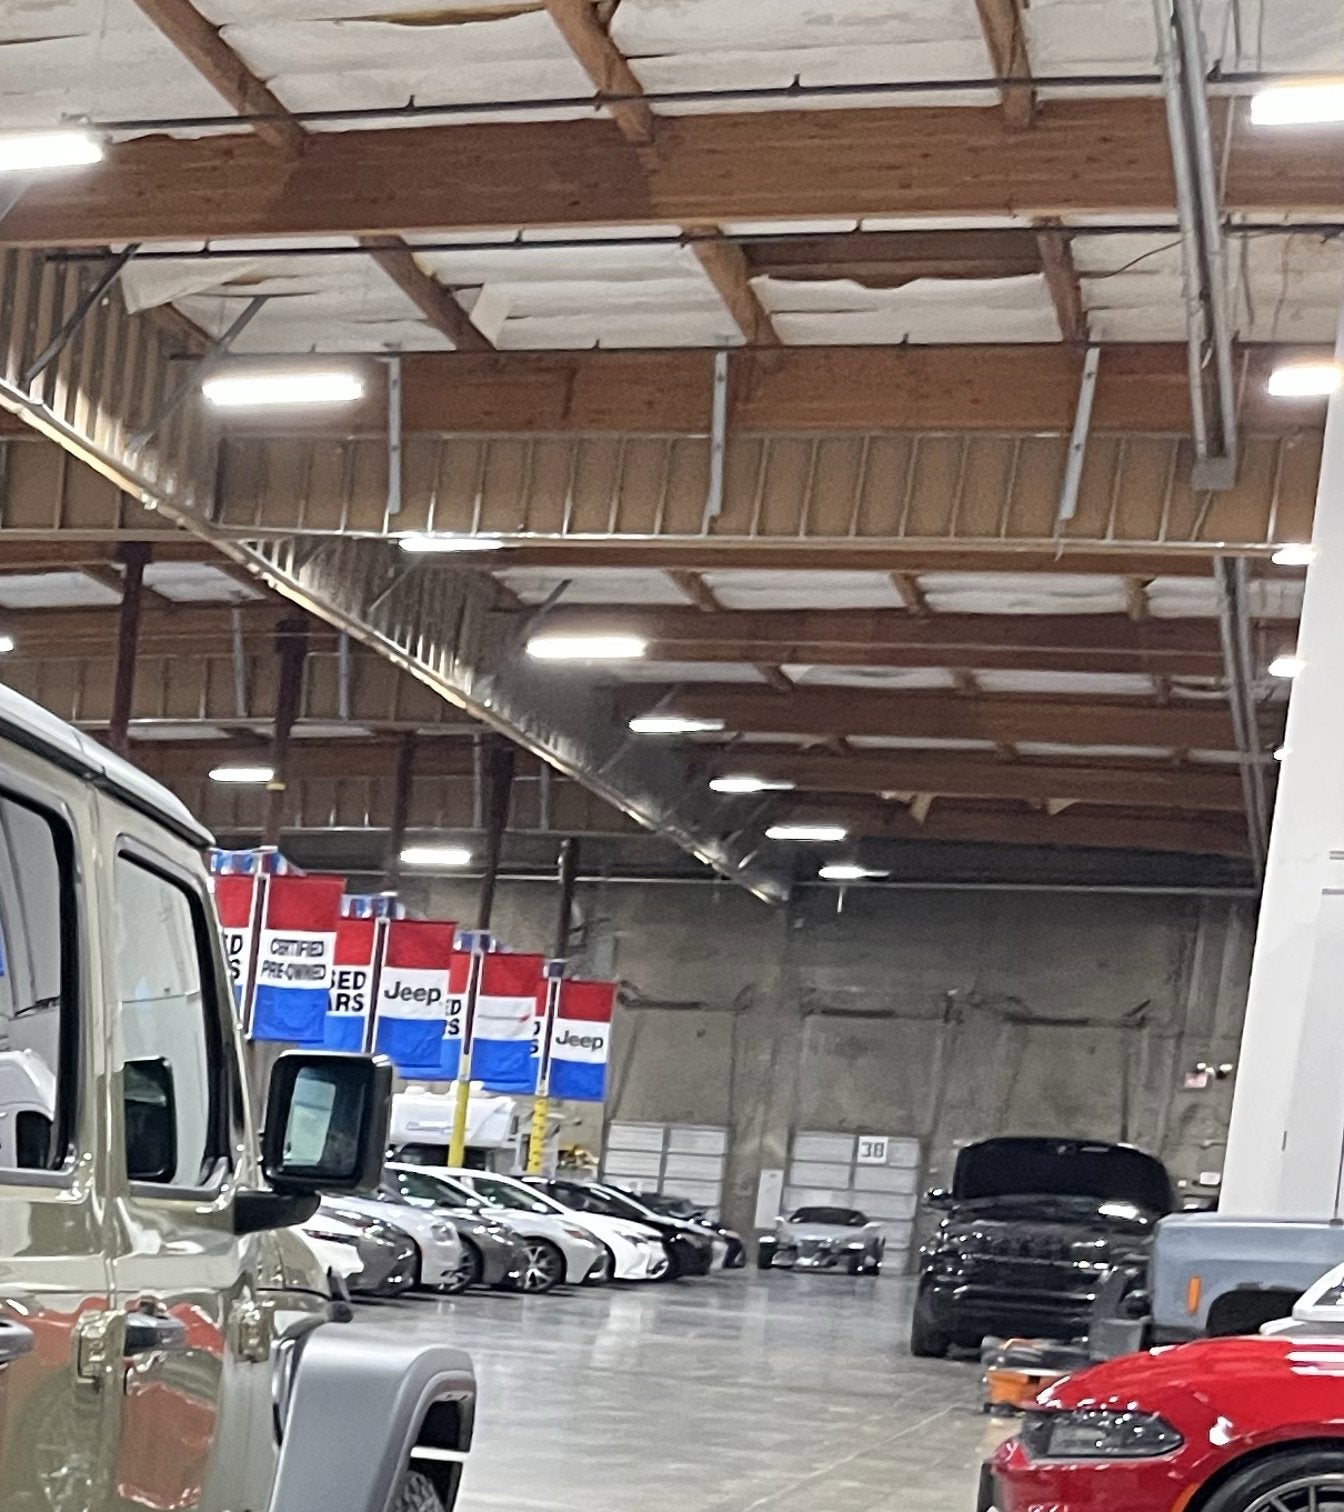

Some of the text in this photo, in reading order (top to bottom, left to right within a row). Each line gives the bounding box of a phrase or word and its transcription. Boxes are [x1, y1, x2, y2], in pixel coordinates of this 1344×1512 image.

[384, 981, 442, 1006] Jeep
[555, 1031, 604, 1051] Jeep
[861, 1141, 885, 1159] 38
